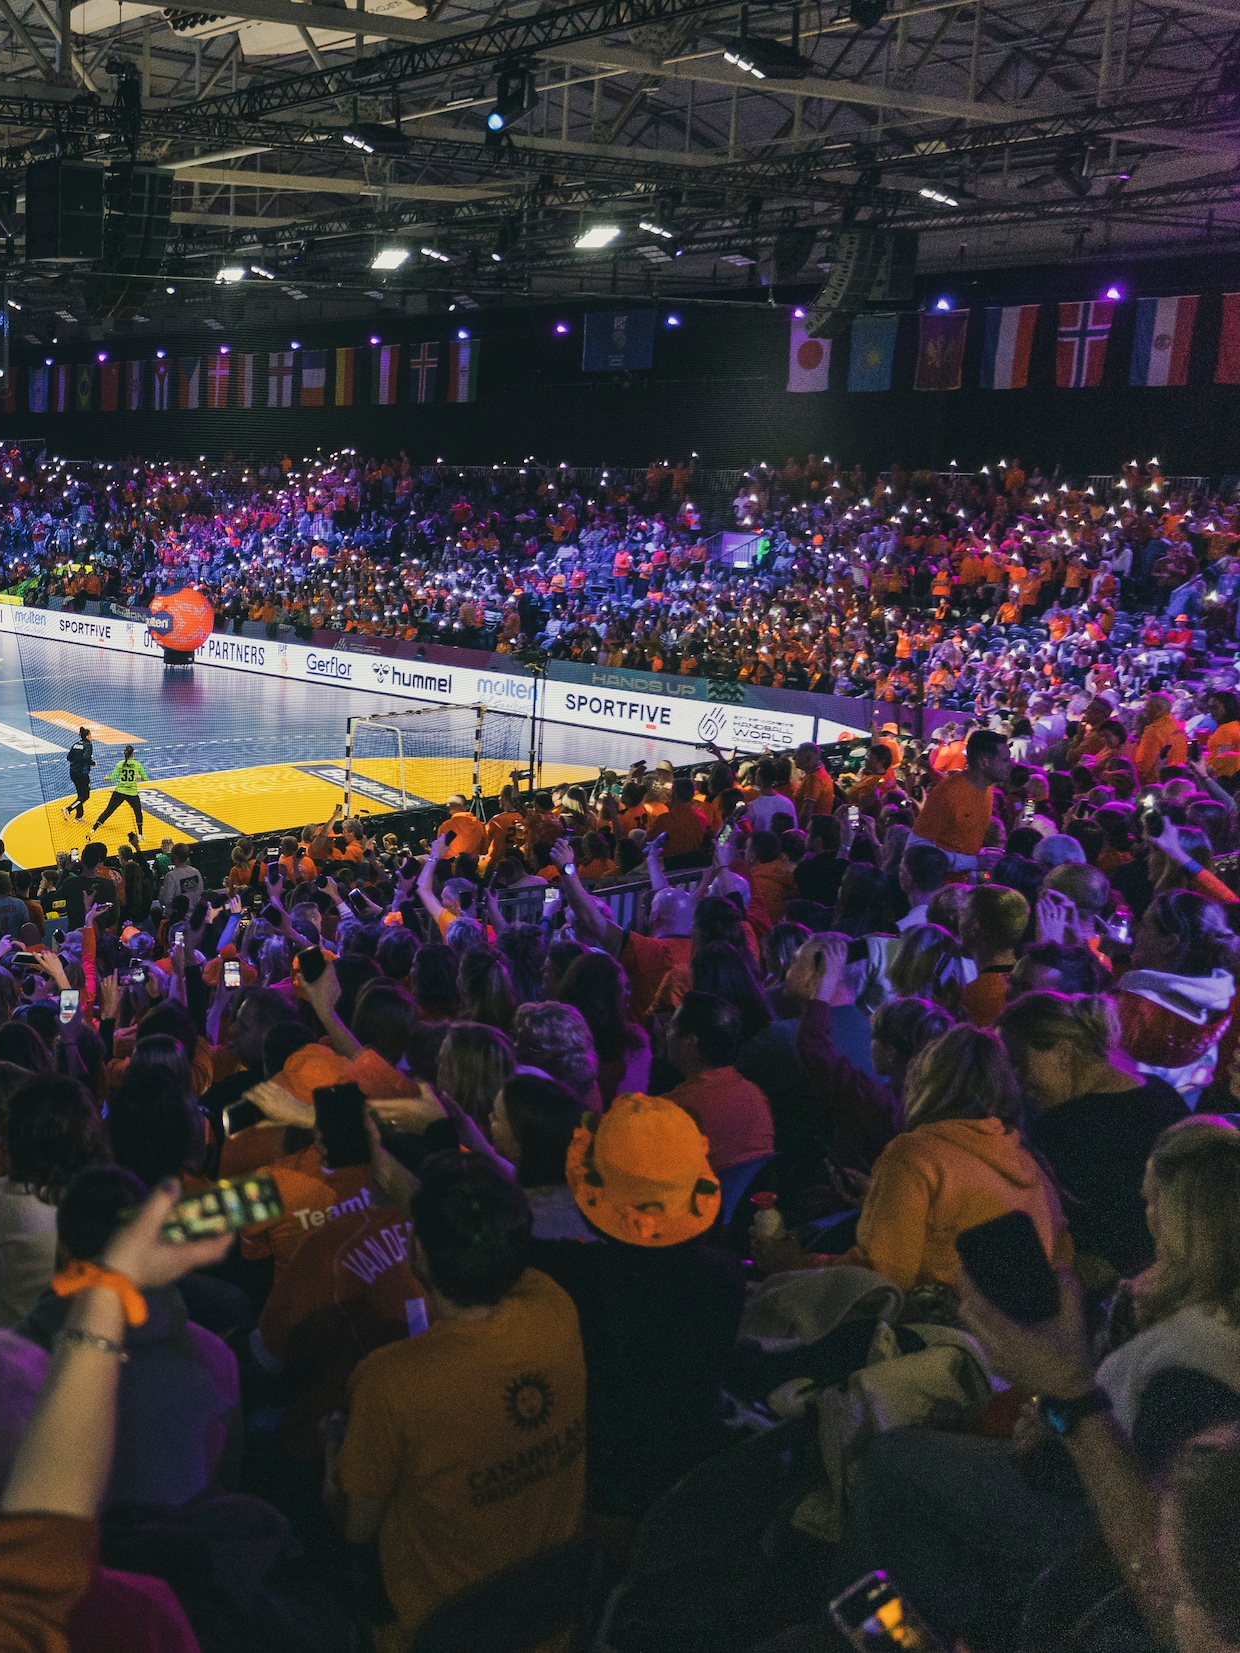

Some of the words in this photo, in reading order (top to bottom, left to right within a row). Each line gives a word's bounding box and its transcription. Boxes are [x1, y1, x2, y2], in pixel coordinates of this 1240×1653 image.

[15, 610, 47, 626] molten
[60, 619, 111, 639] SPORTFIVE
[209, 639, 265, 666] PARTNERS
[306, 653, 352, 677] Gerflor
[392, 666, 452, 694] hummel
[592, 672, 662, 692] HANDS
[666, 683, 696, 696] UP
[565, 693, 671, 726] SPORTFIVE
[733, 721, 794, 735] HANDBALL
[733, 727, 793, 744] WORLD
[121, 769, 135, 782] 33
[341, 1236, 394, 1285] VAN
